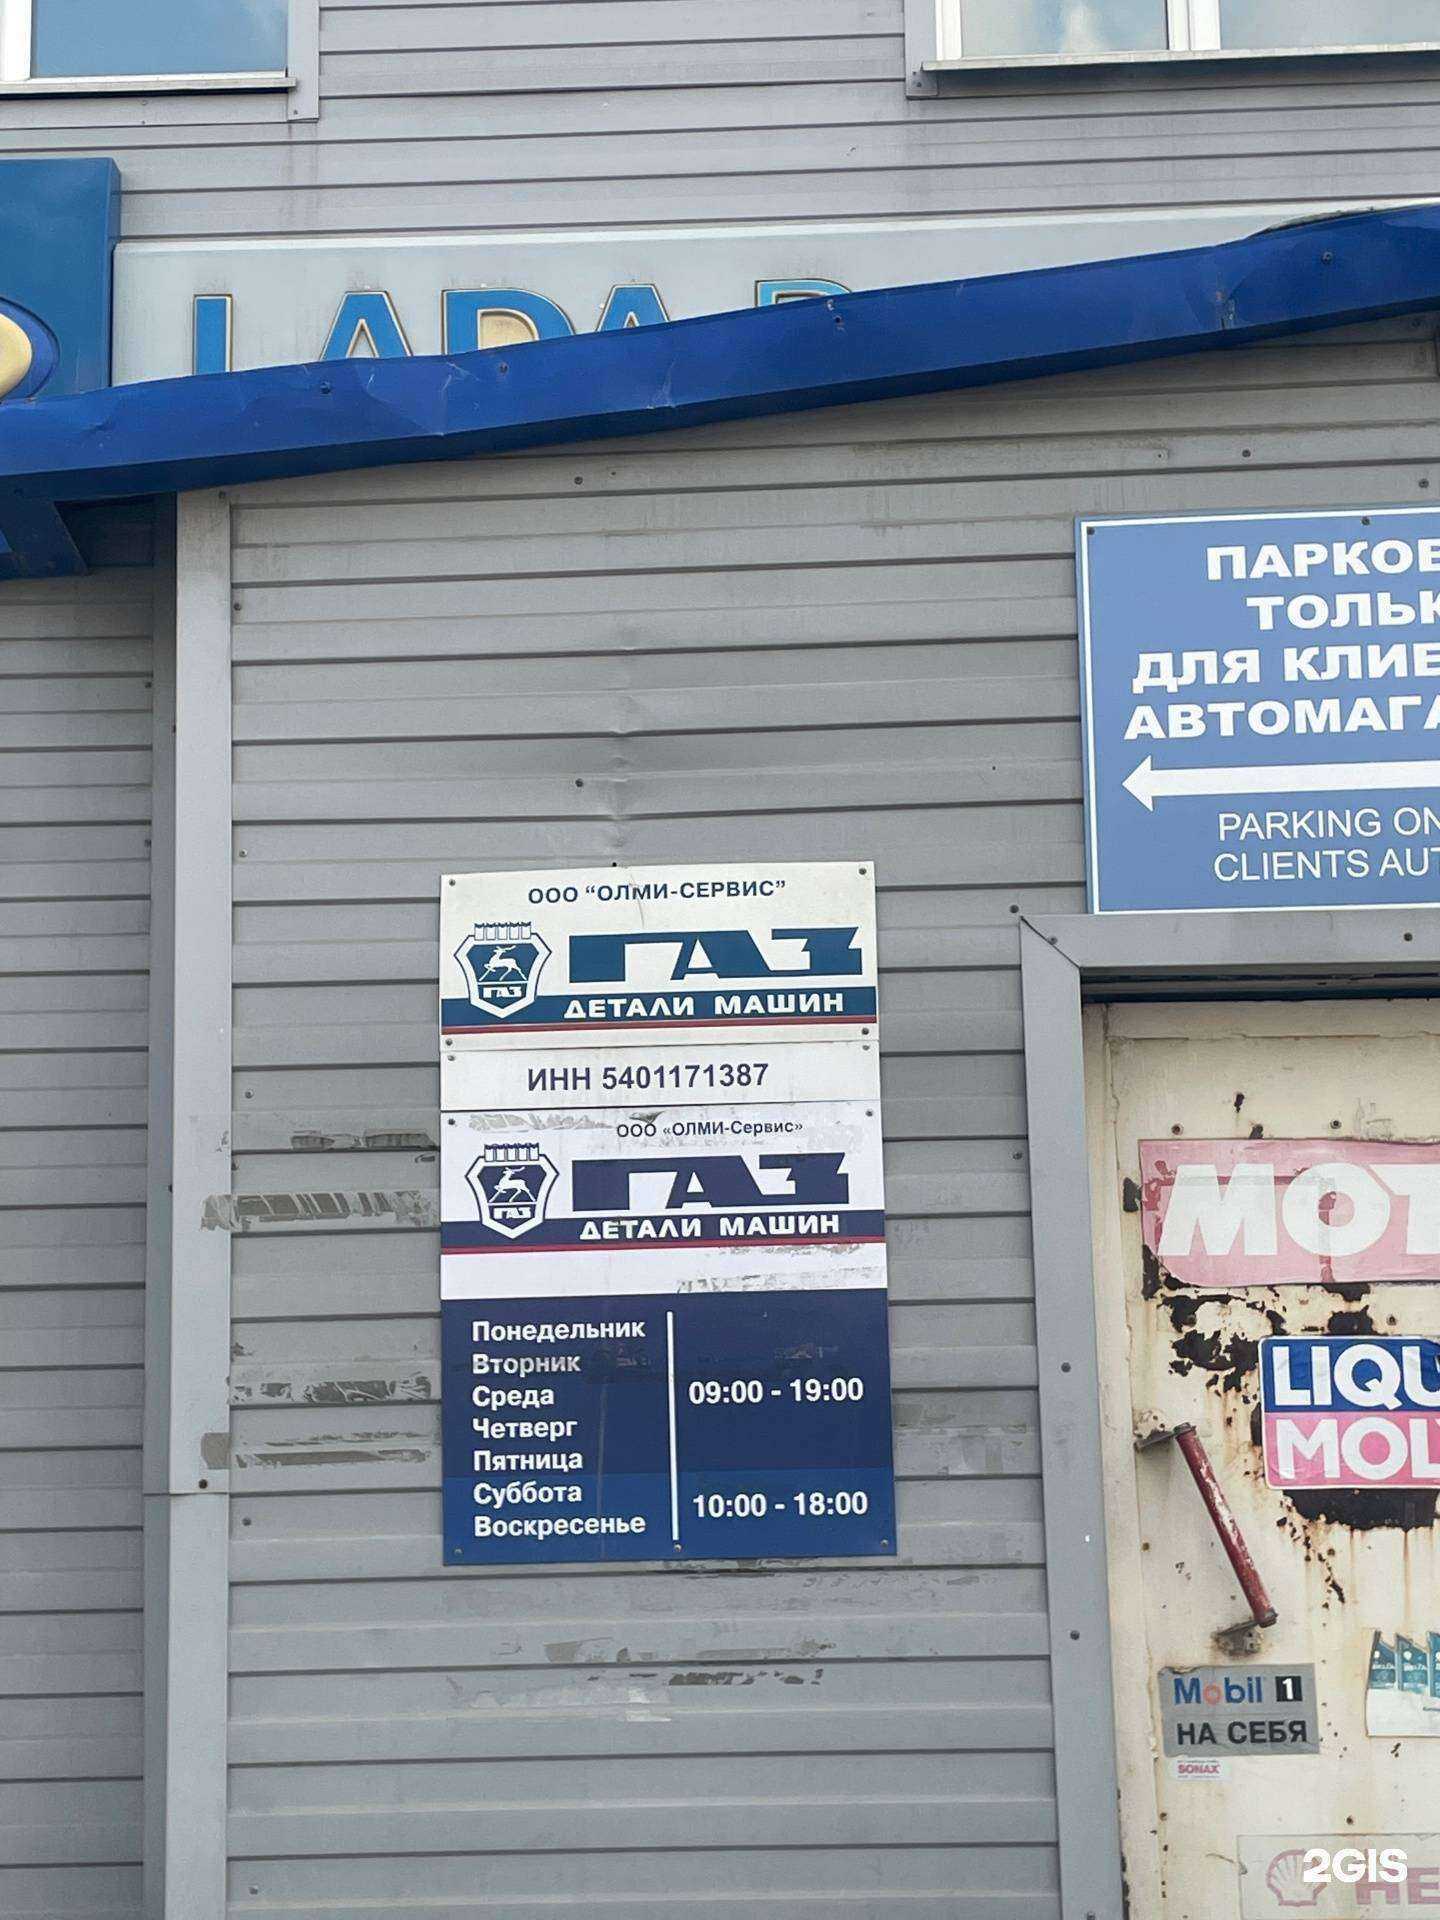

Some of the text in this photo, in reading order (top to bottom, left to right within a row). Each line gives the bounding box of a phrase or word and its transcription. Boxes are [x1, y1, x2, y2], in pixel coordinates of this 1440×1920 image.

[1132, 642, 1440, 694] ДЛЯ КЛИЕ
[1218, 809, 1381, 840] PARKING
[1214, 850, 1368, 881] CLIENTS
[528, 887, 578, 904] ООО
[569, 927, 863, 983] ГАЗ
[483, 986, 521, 999] ГАЗ
[564, 993, 844, 1018] ДЕТАЛИ МАШИН
[528, 1064, 768, 1091] ИНН 5401171387
[617, 1122, 656, 1138] ООО
[572, 1152, 849, 1211] ГАЗ
[494, 1207, 531, 1219] ГАЗ
[1157, 1162, 1440, 1256] MOT
[579, 1214, 839, 1240] ДЕТАЛИ МАШИН
[472, 1319, 646, 1344] Понедельник
[472, 1354, 581, 1377] Вторник
[1272, 1344, 1440, 1410] LIQU
[472, 1386, 554, 1410] Среда
[689, 1380, 763, 1404] 09:00
[790, 1377, 864, 1401] 19:00
[473, 1418, 577, 1442] Четверг
[1276, 1417, 1440, 1480] MOL
[473, 1450, 583, 1474] Пятница
[473, 1482, 582, 1509] Суббота
[693, 1494, 766, 1518] 10:00
[794, 1491, 868, 1515] 18:00
[474, 1515, 646, 1539] Воскресенье
[1174, 1676, 1262, 1705] Mobil
[1177, 1720, 1307, 1745] НА СЕБЯ
[1178, 1764, 1220, 1774] SONAX
